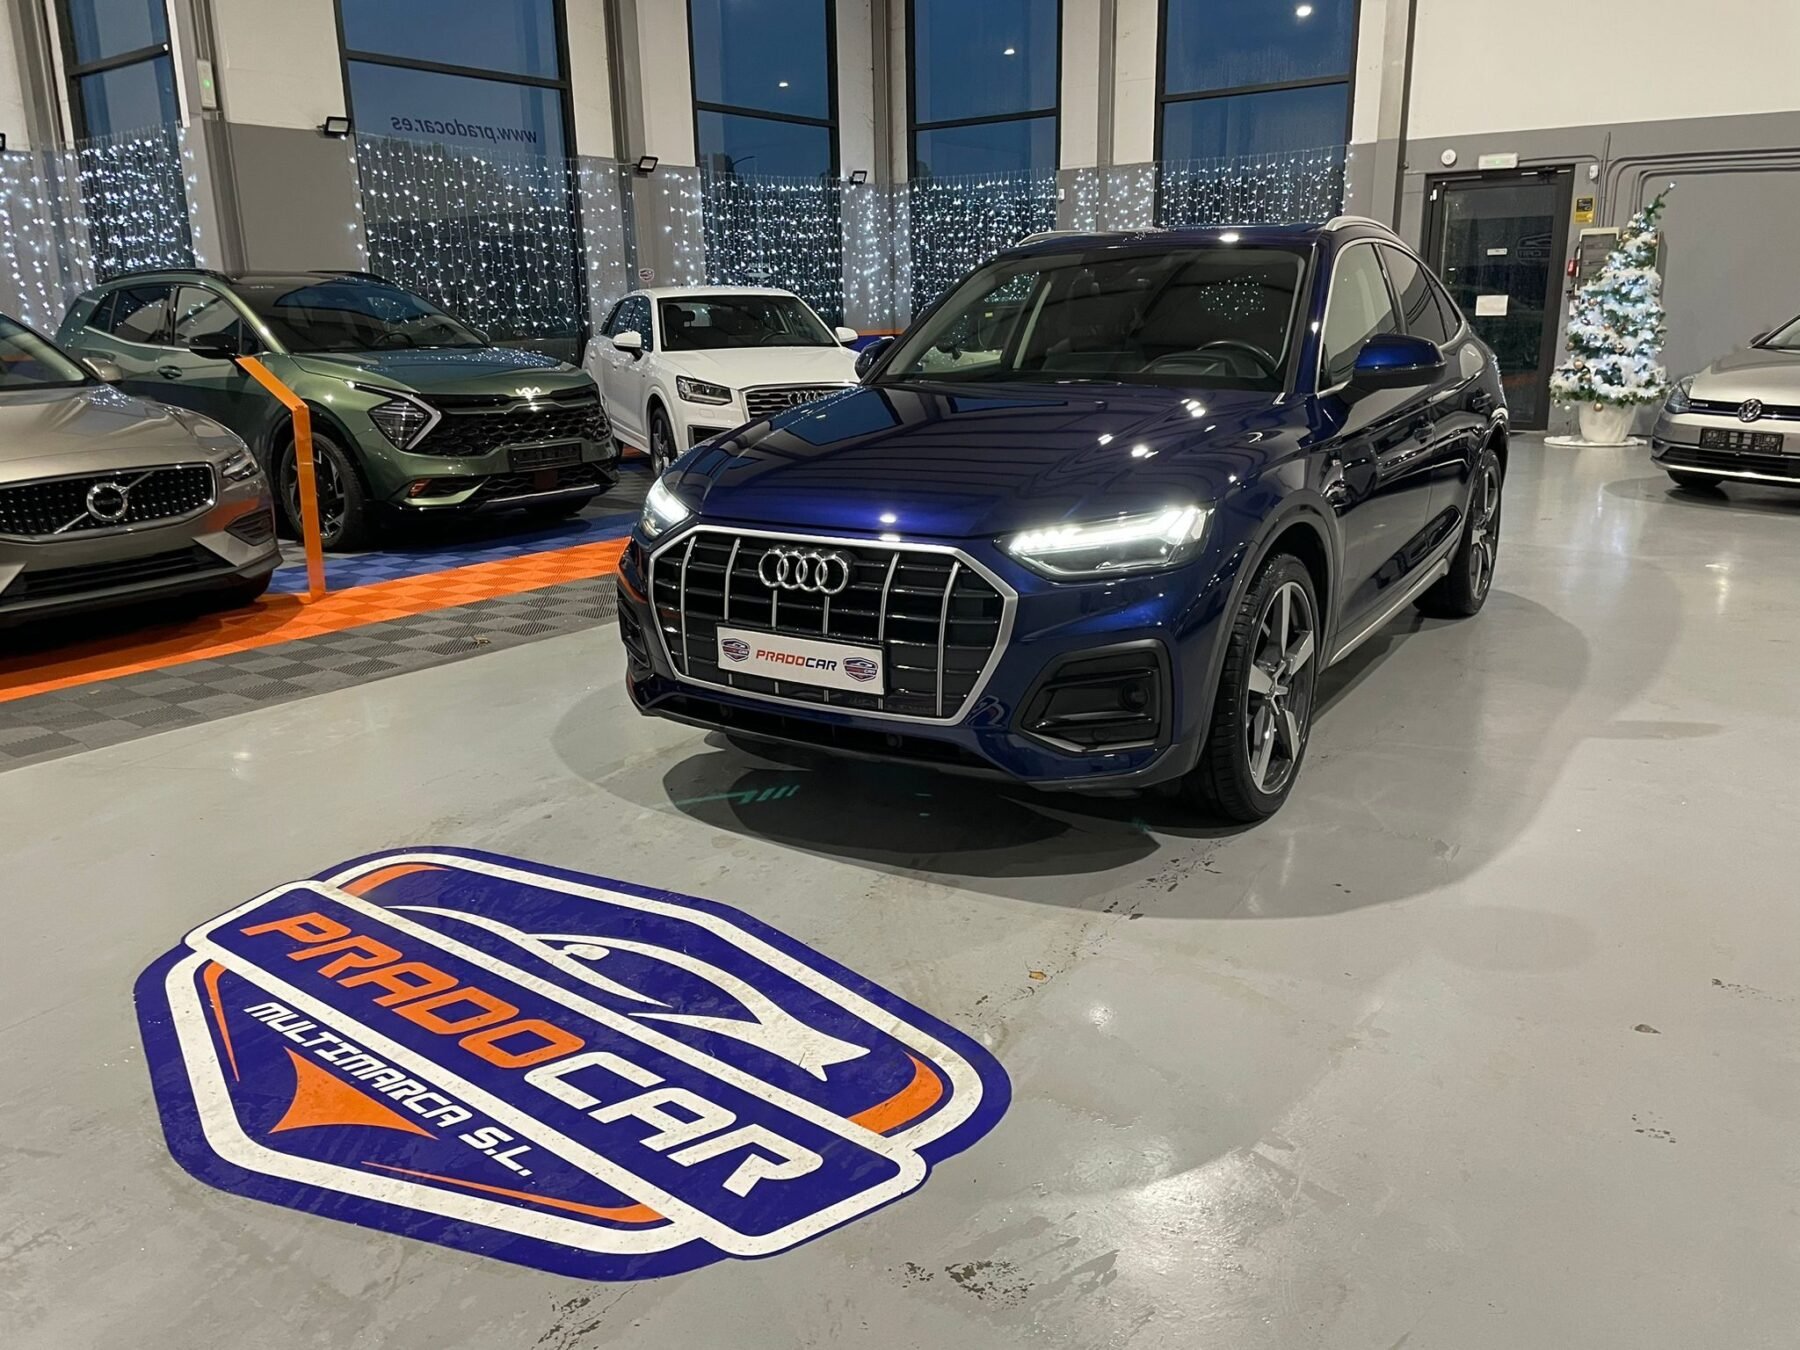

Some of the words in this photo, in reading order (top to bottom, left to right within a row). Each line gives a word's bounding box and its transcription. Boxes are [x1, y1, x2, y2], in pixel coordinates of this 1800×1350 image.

[756, 650, 838, 671] PRADOCAR
[241, 912, 823, 1197] PRADOCAR
[243, 1001, 473, 1129] MULTIMARCA
[457, 1126, 536, 1178] S.L.
